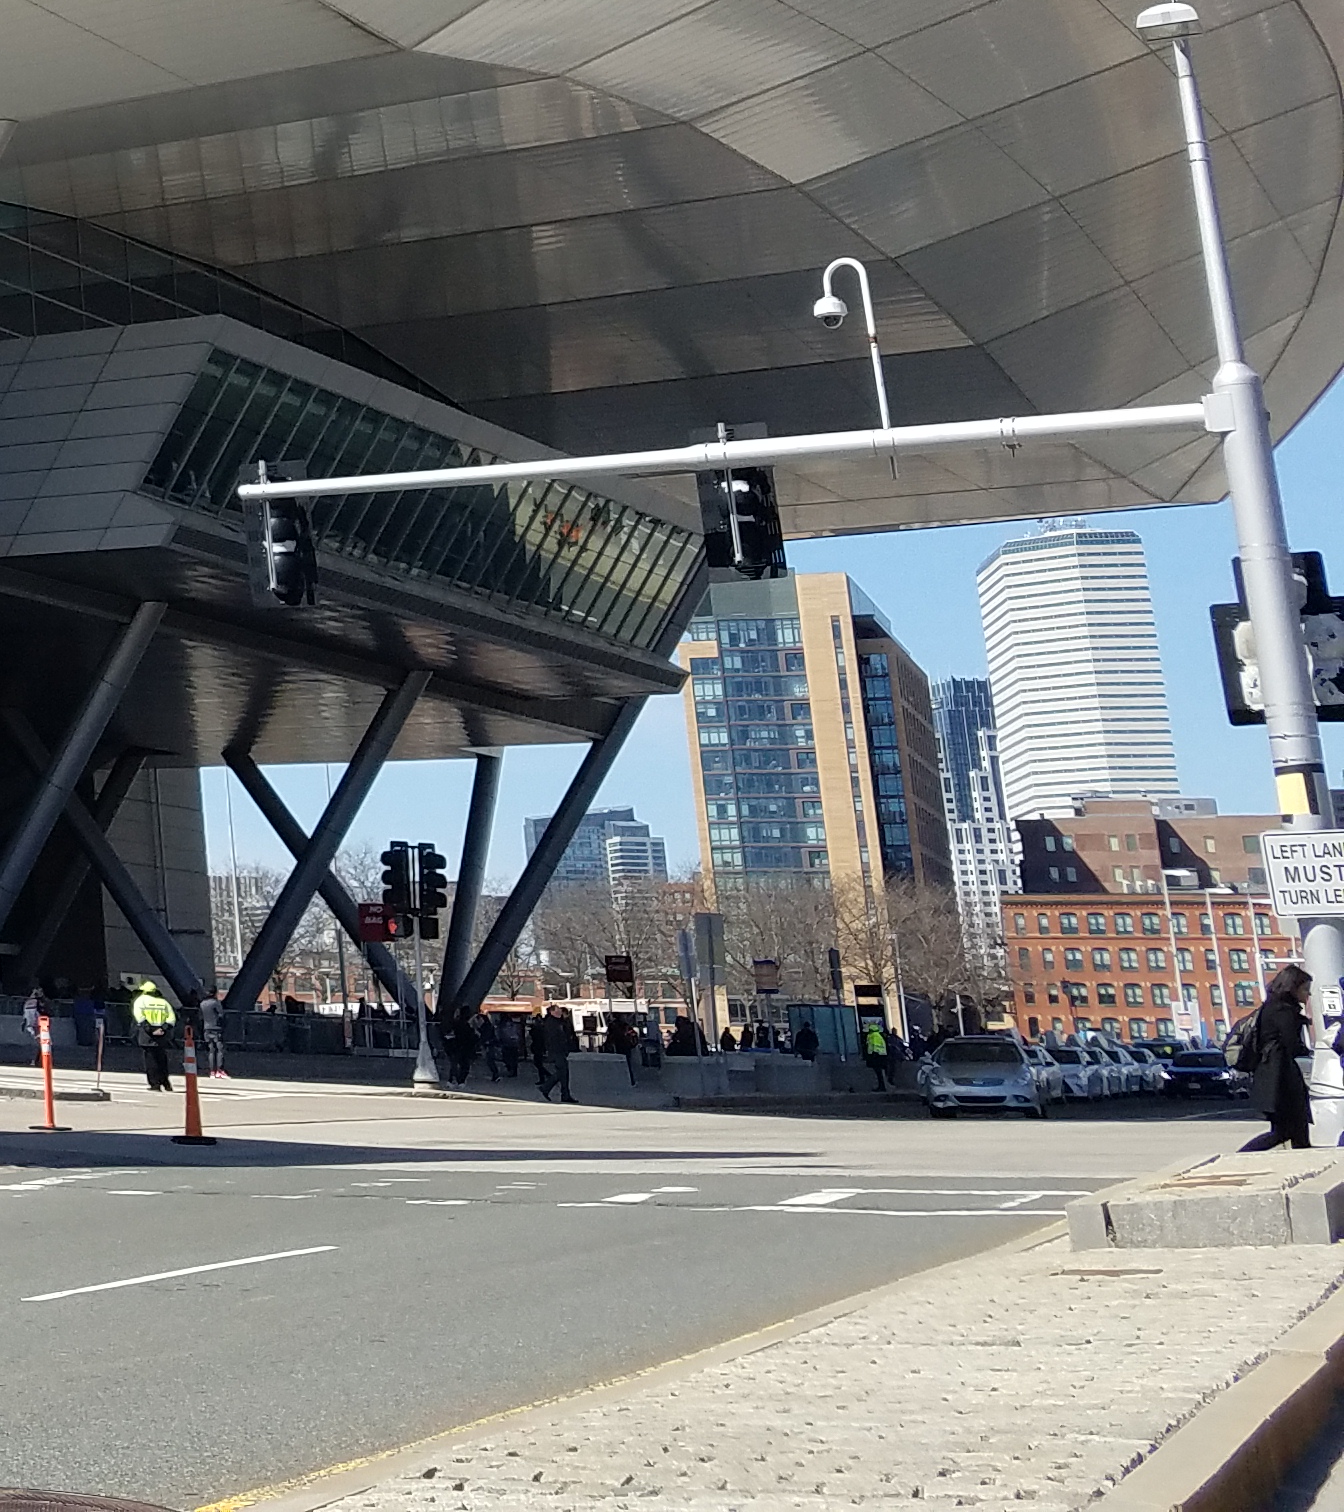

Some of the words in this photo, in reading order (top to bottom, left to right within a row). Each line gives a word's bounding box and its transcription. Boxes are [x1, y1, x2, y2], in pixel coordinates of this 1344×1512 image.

[1271, 843, 1307, 859] LEFT
[1312, 842, 1344, 858] LAN
[1284, 864, 1344, 883] MUST
[1279, 889, 1321, 905] TURN
[1324, 888, 1344, 904] LE
